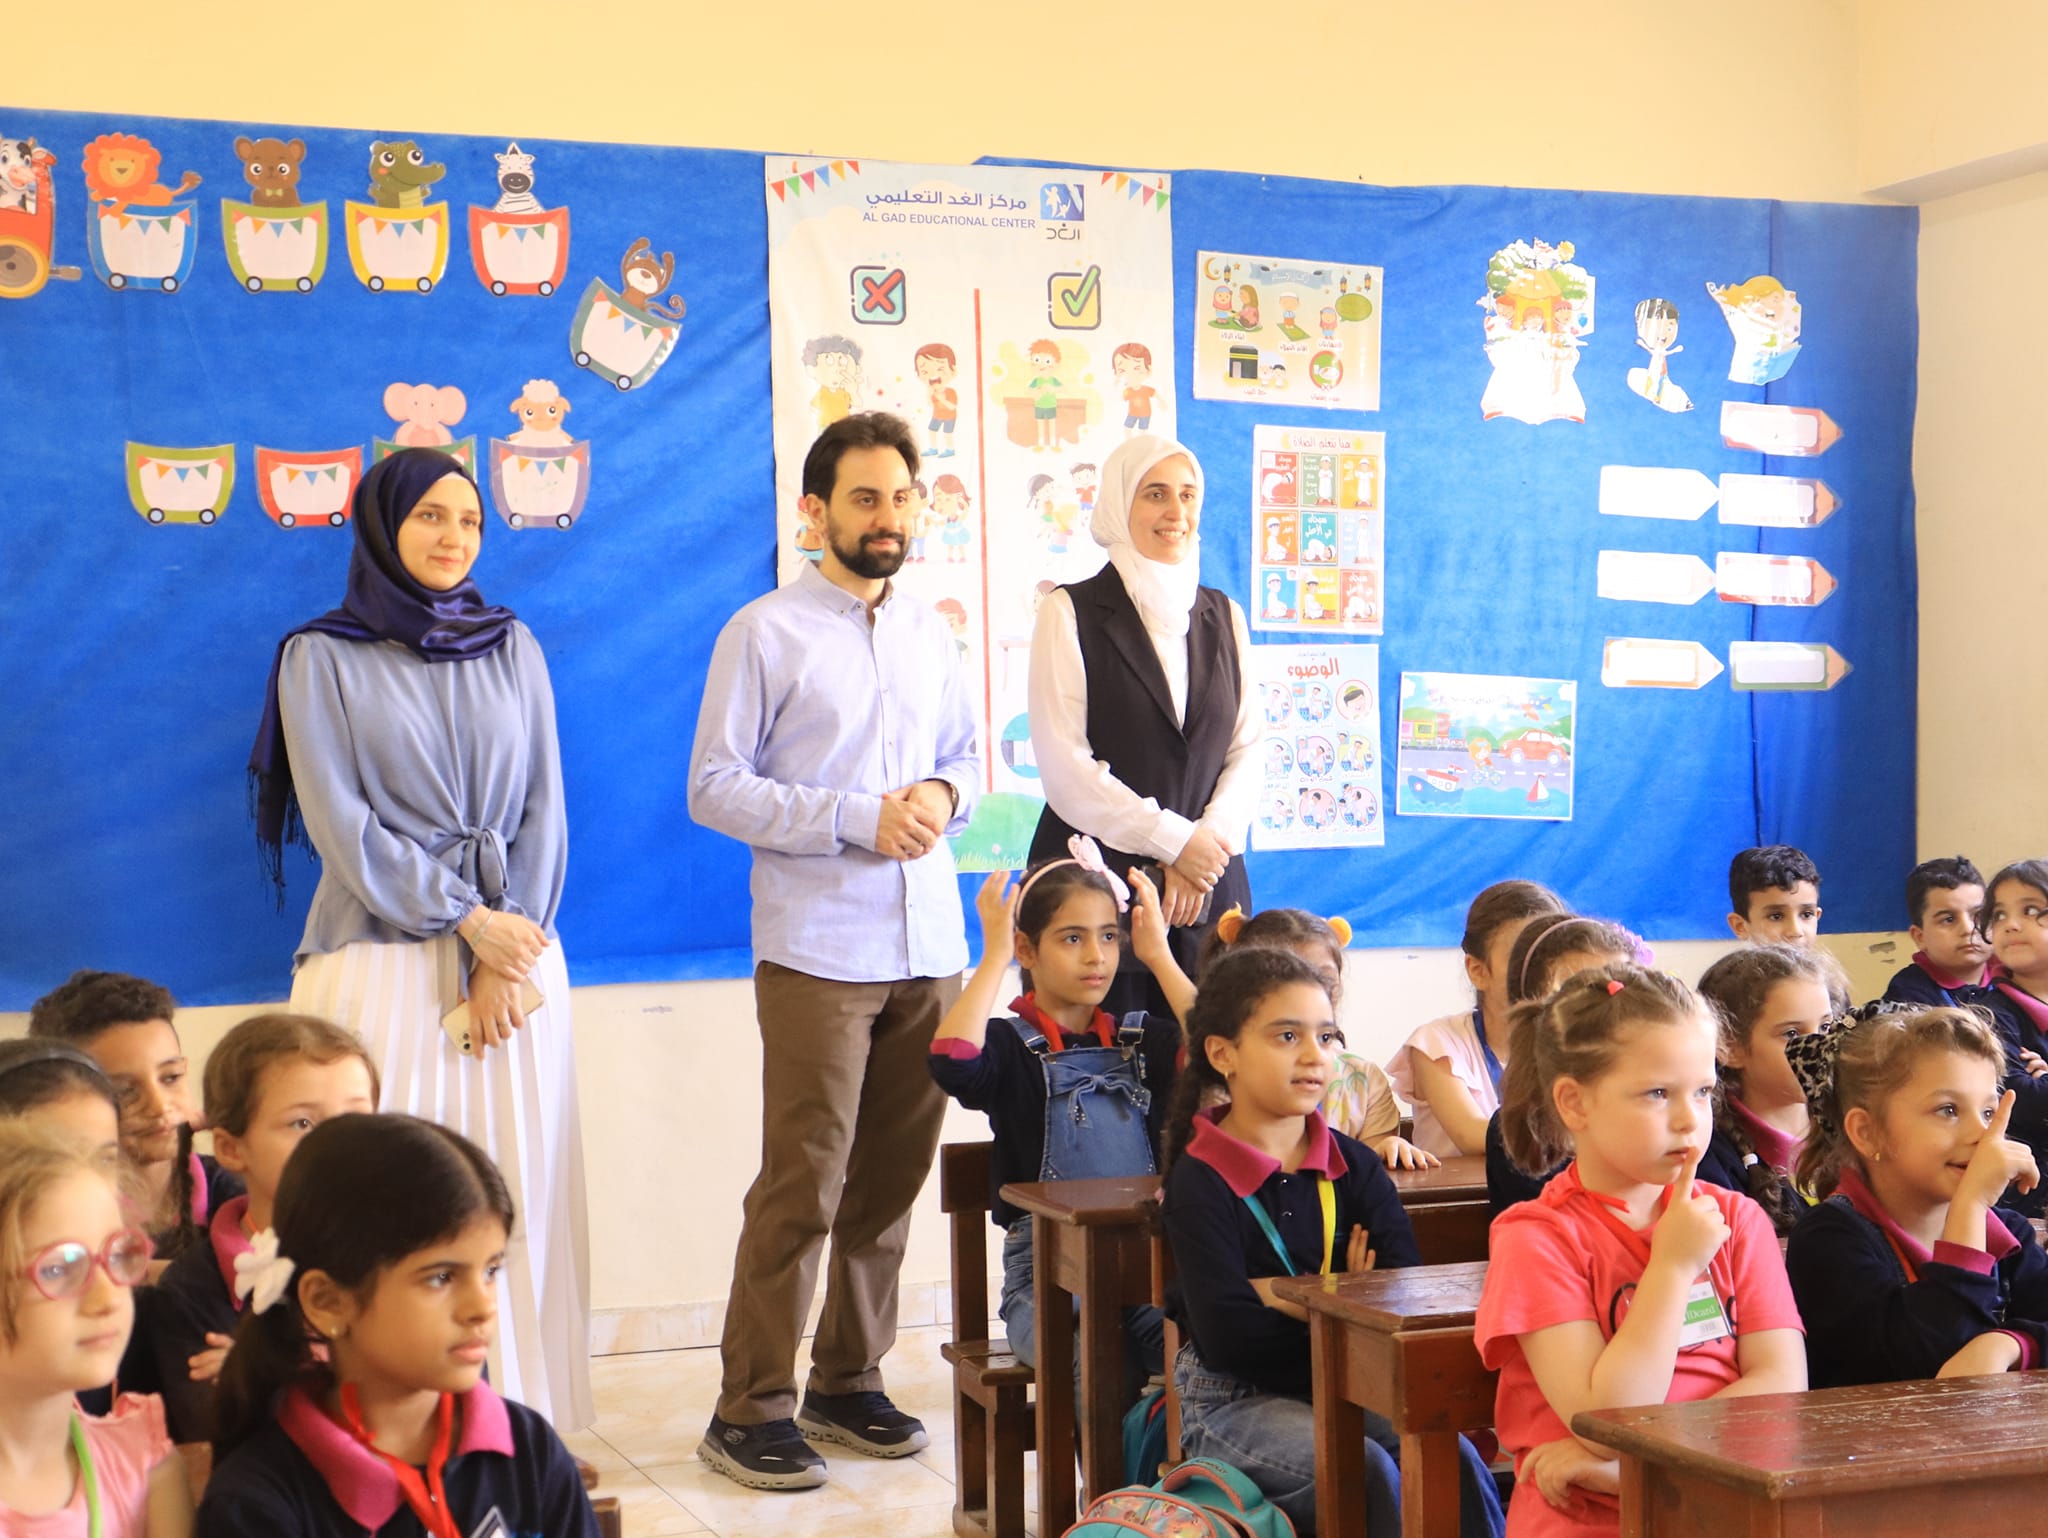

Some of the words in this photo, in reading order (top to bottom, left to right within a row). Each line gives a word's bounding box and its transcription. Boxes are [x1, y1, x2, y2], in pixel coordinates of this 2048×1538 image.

[865, 189, 943, 209] التعليمي
[947, 193, 984, 208] الغد
[988, 193, 1028, 212] مركز
[862, 212, 878, 222] AL
[881, 213, 907, 224] GAD
[909, 213, 989, 227] EDUCATIONAL
[991, 217, 1036, 229] CENTER
[1287, 657, 1341, 679] الوضوء
